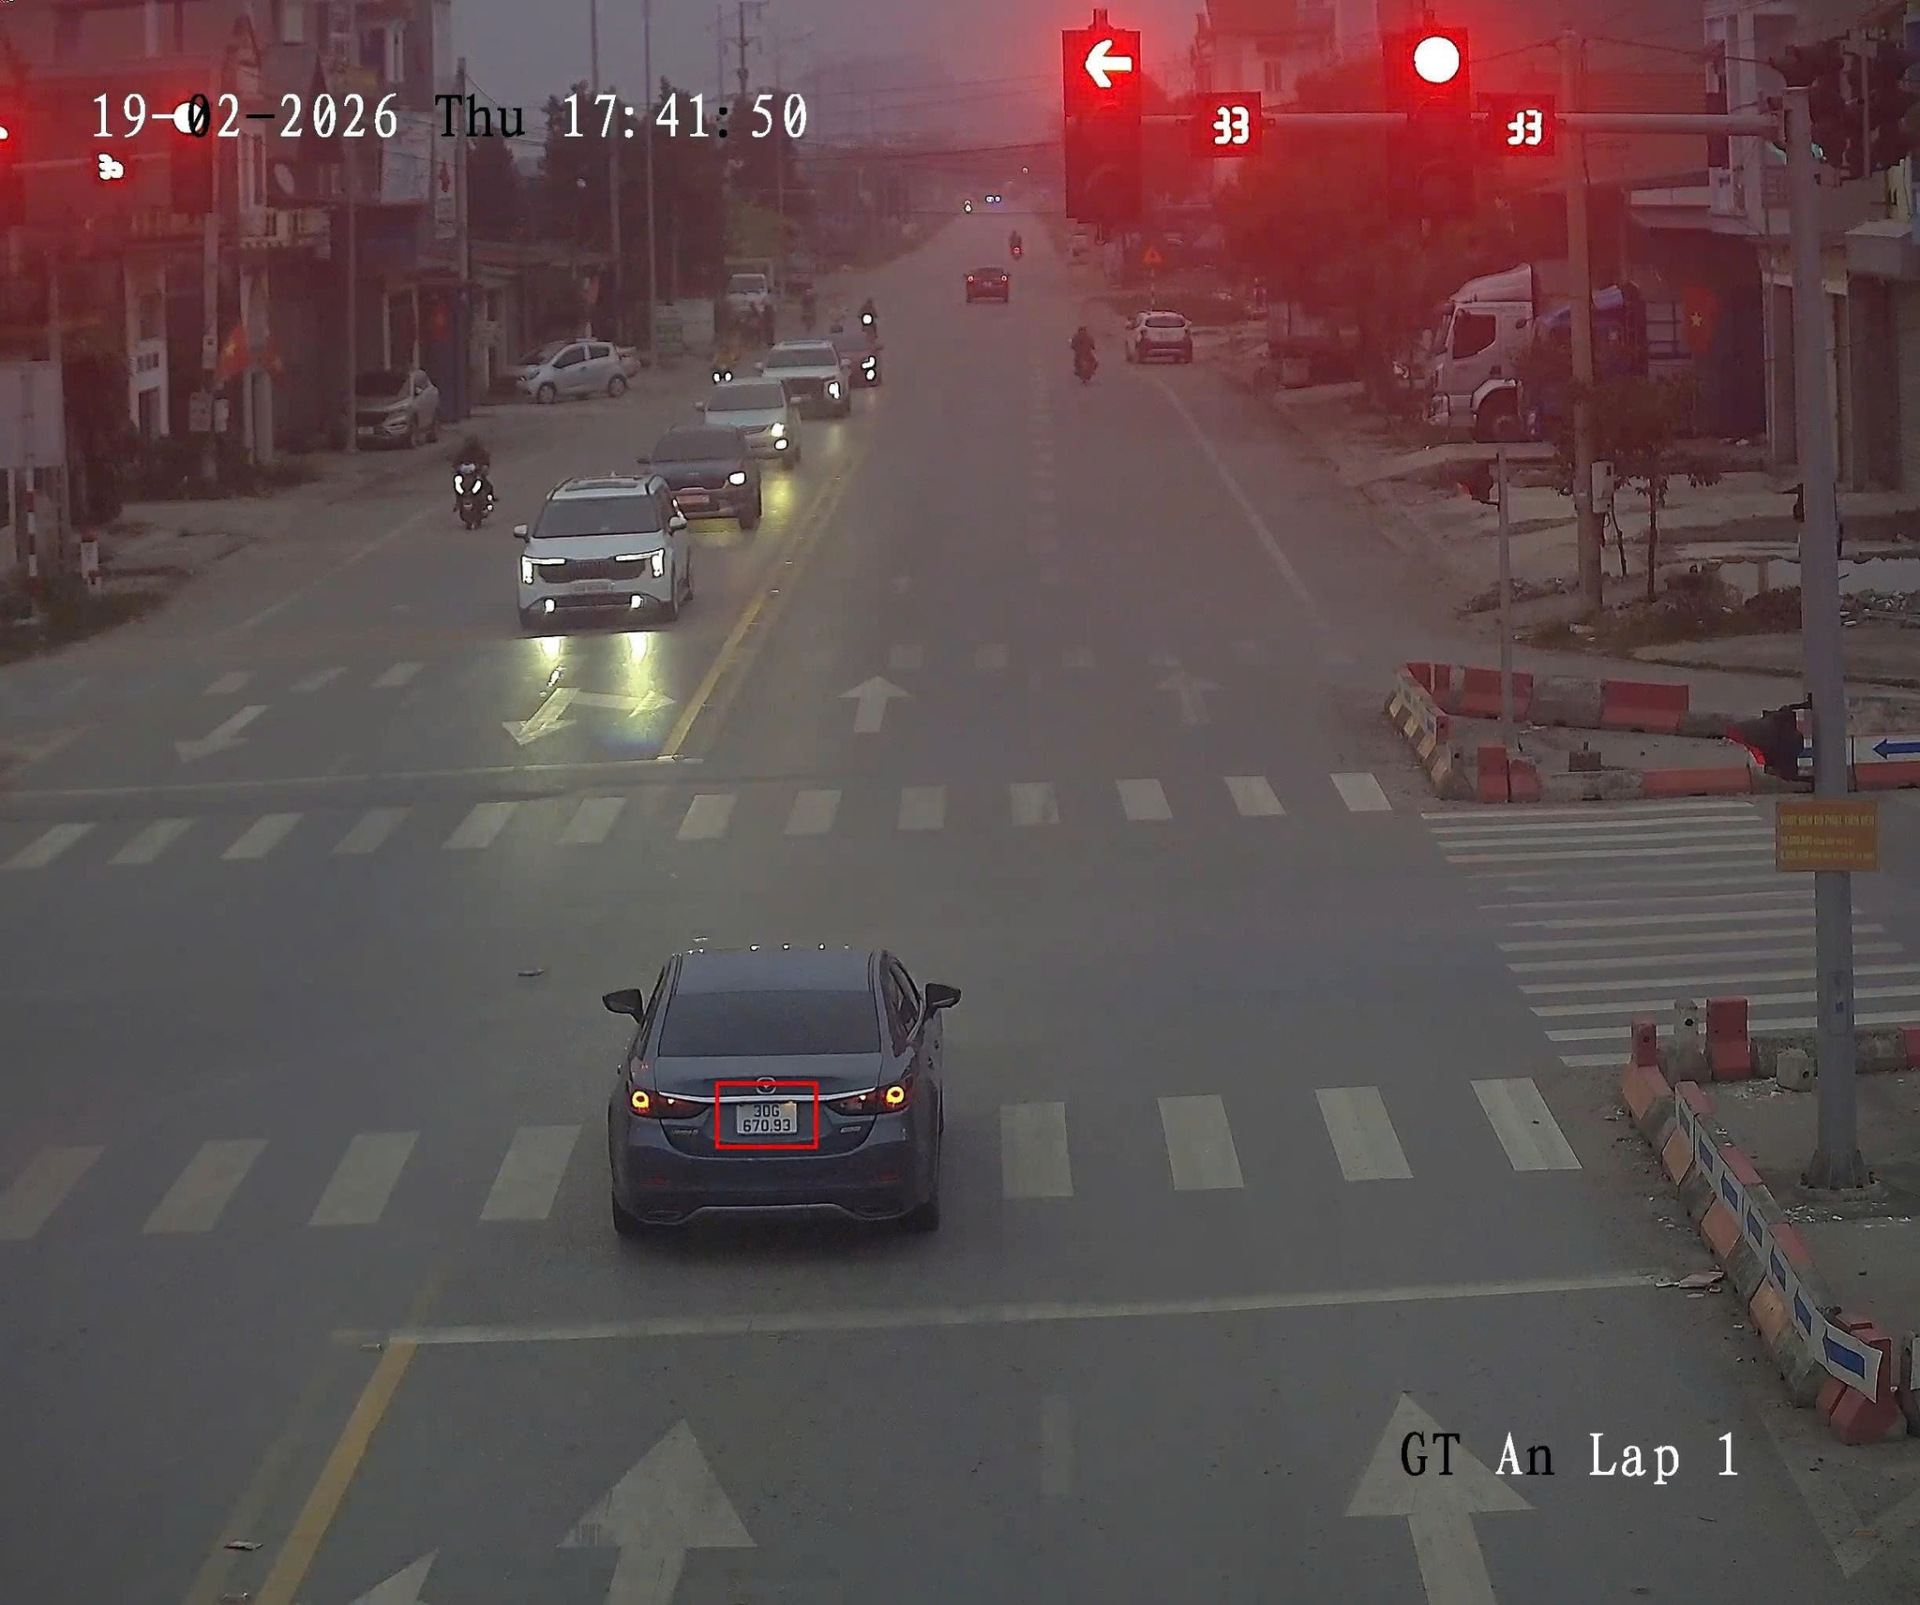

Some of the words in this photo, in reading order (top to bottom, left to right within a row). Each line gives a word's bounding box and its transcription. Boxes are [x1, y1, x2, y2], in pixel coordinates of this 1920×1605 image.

[1213, 105, 1249, 145] 33
[753, 1103, 780, 1118] 30G
[743, 1118, 791, 1132] 670.93
